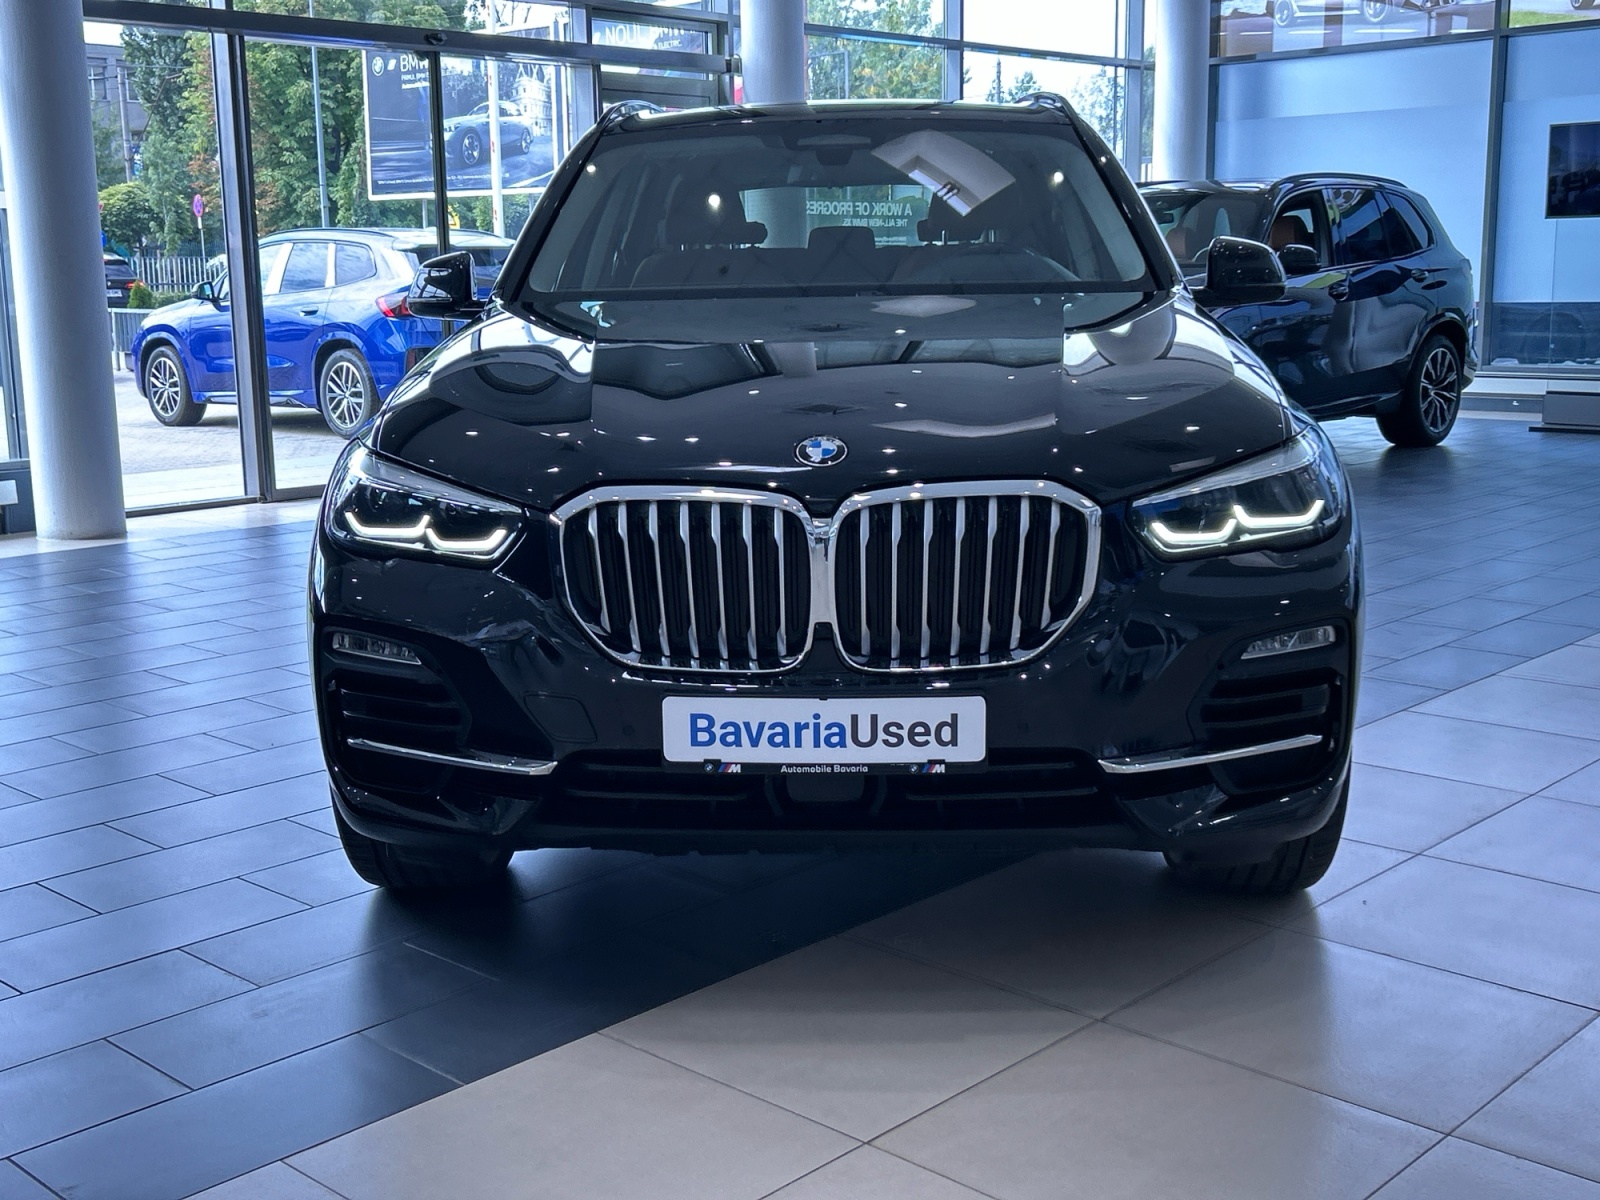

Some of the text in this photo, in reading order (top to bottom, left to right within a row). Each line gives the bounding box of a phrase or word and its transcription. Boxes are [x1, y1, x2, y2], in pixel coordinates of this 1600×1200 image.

[689, 712, 958, 749] BavariaUsed
[780, 764, 869, 773] Automobile Bavaria
